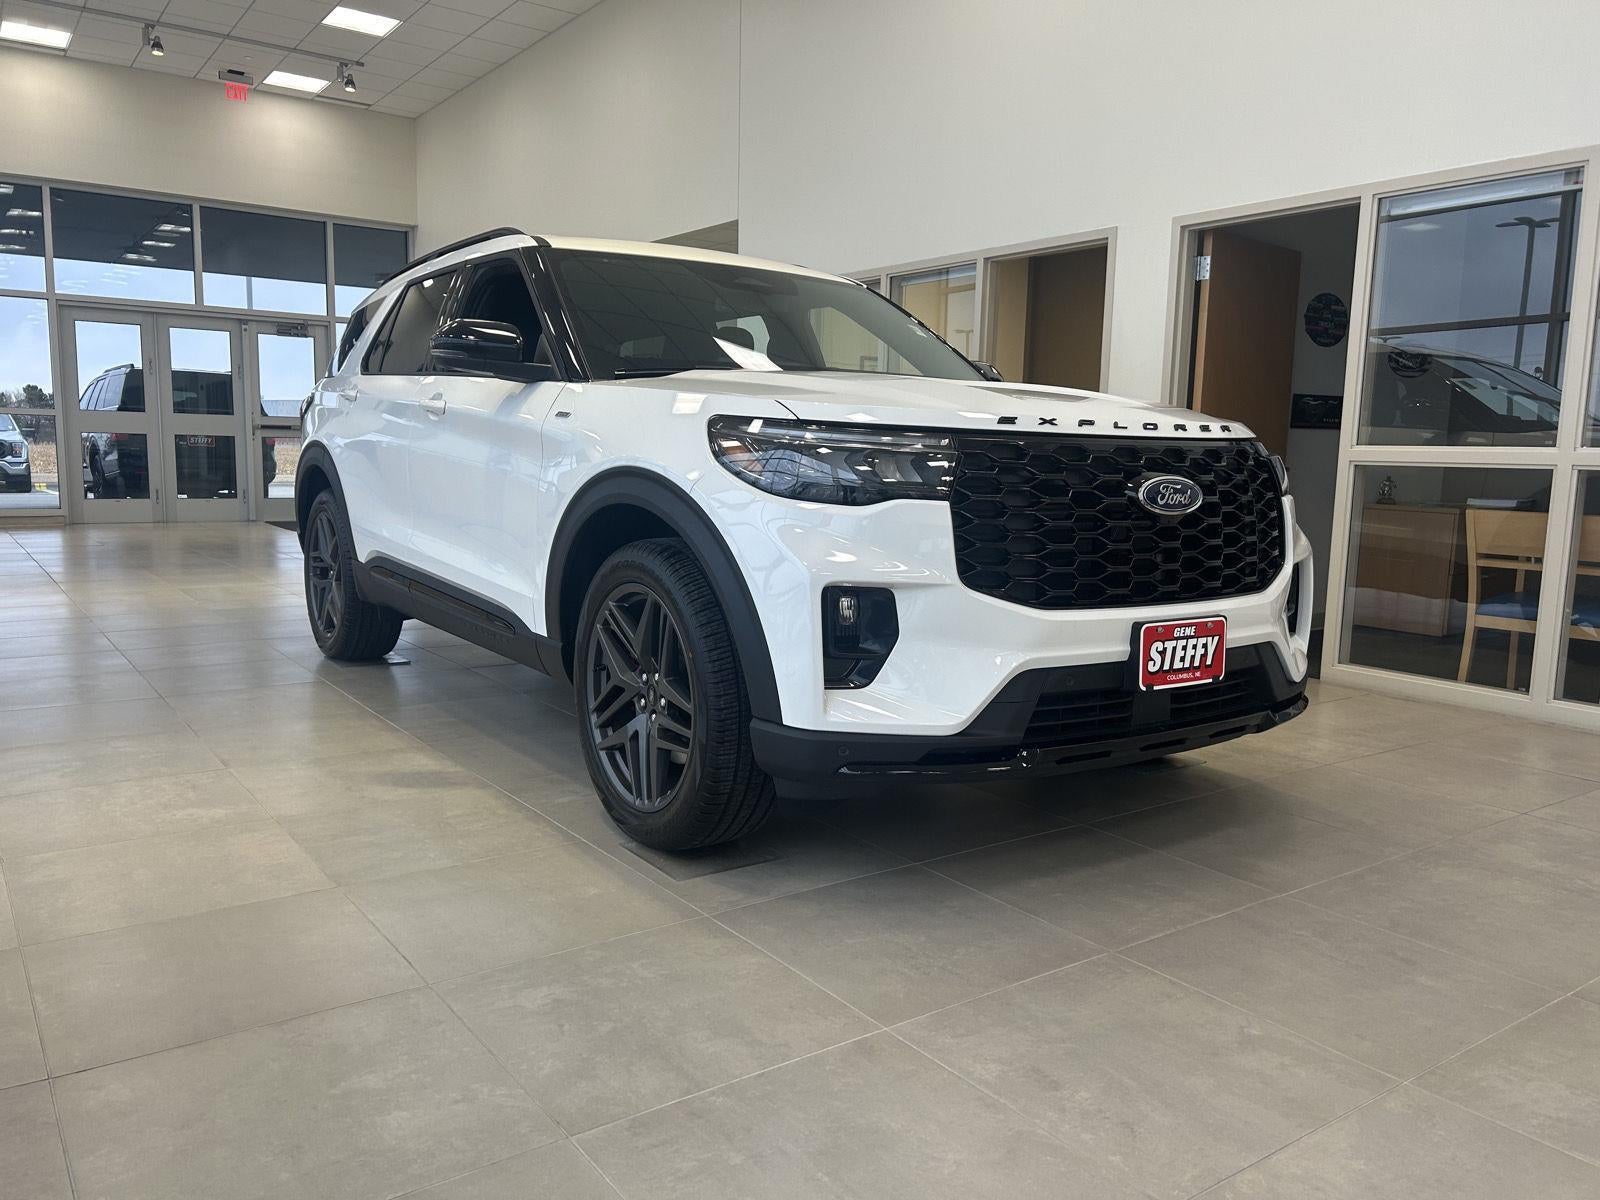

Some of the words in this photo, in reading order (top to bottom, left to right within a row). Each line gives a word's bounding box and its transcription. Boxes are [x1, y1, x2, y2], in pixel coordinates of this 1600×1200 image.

[225, 82, 248, 102] EXIT
[997, 416, 1232, 433] EXPLORER
[1157, 483, 1192, 505] Ford
[1173, 626, 1197, 637] GENE
[1147, 635, 1220, 673] STEFFY
[1166, 672, 1193, 681] COLUMBUS,
